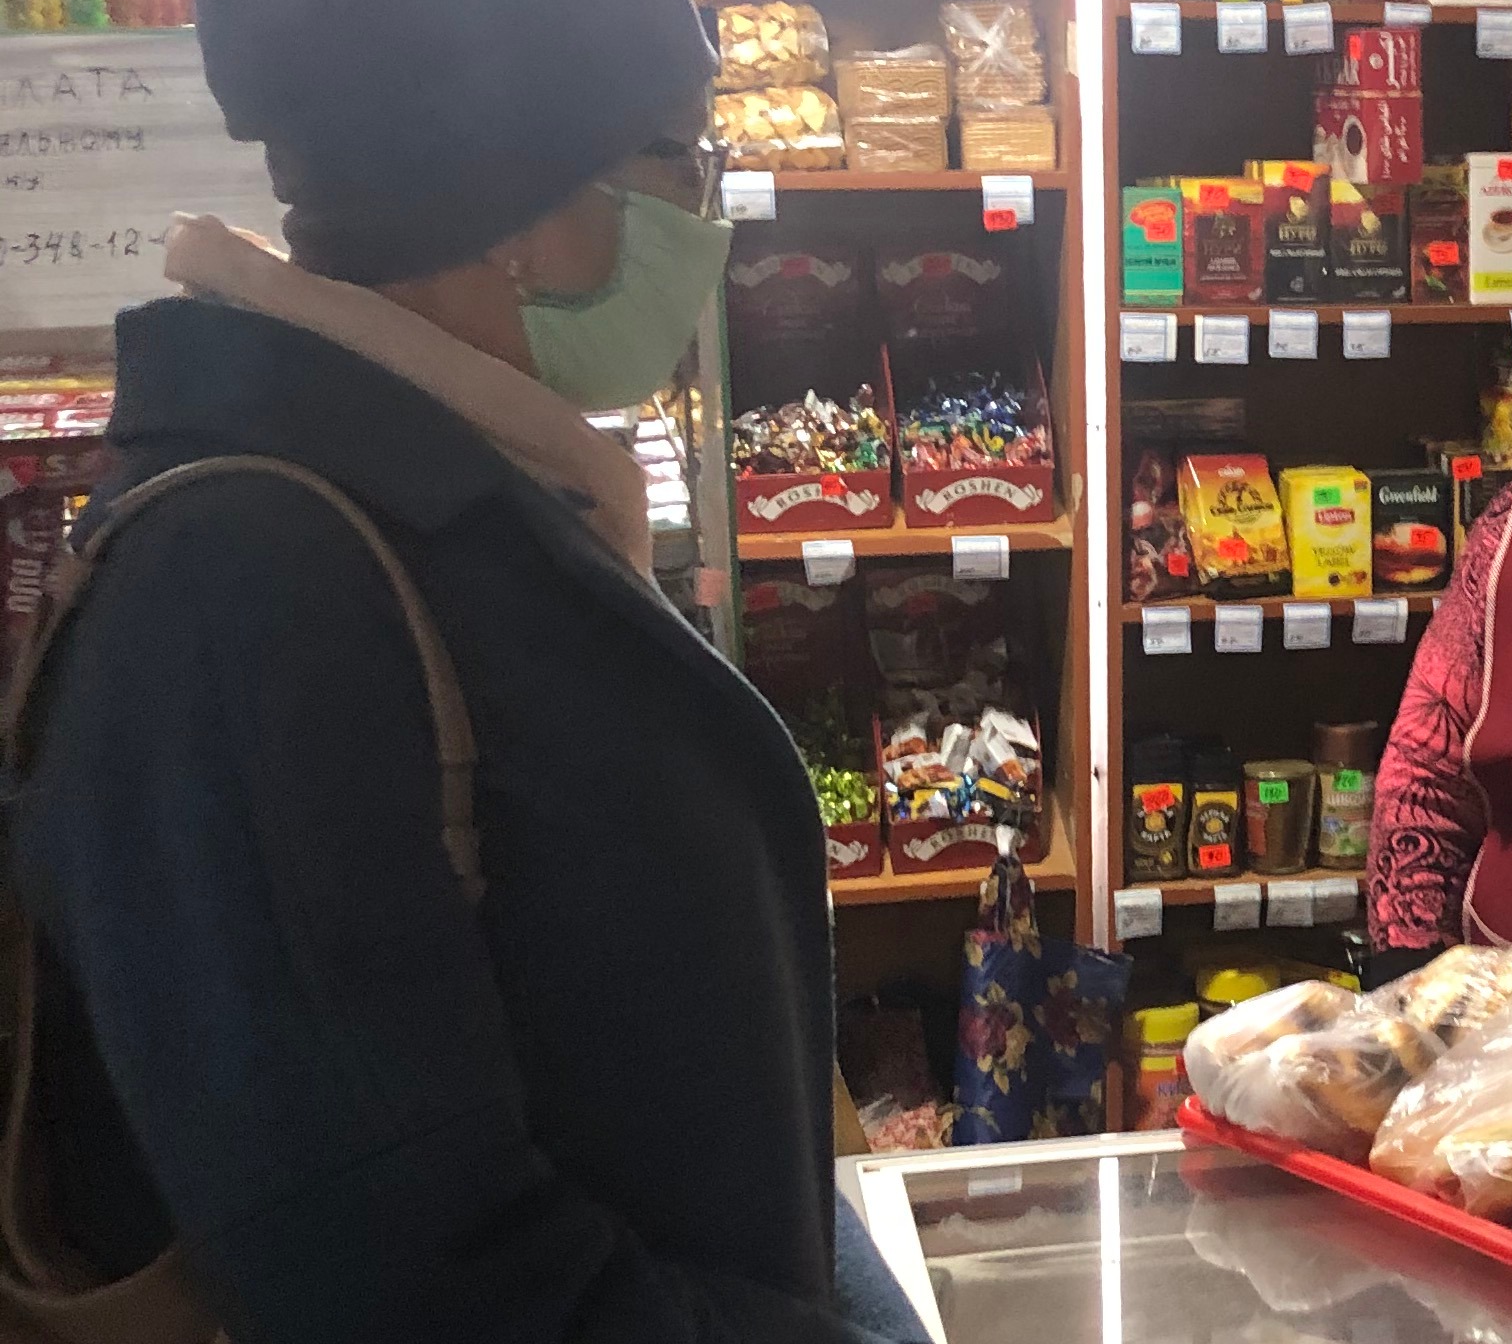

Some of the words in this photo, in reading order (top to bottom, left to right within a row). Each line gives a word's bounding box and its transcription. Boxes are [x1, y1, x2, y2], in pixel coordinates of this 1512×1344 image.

[0, 66, 153, 104] ЛАТА
[944, 480, 1015, 502] ROSHEN
[1379, 485, 1439, 506] Greenfield
